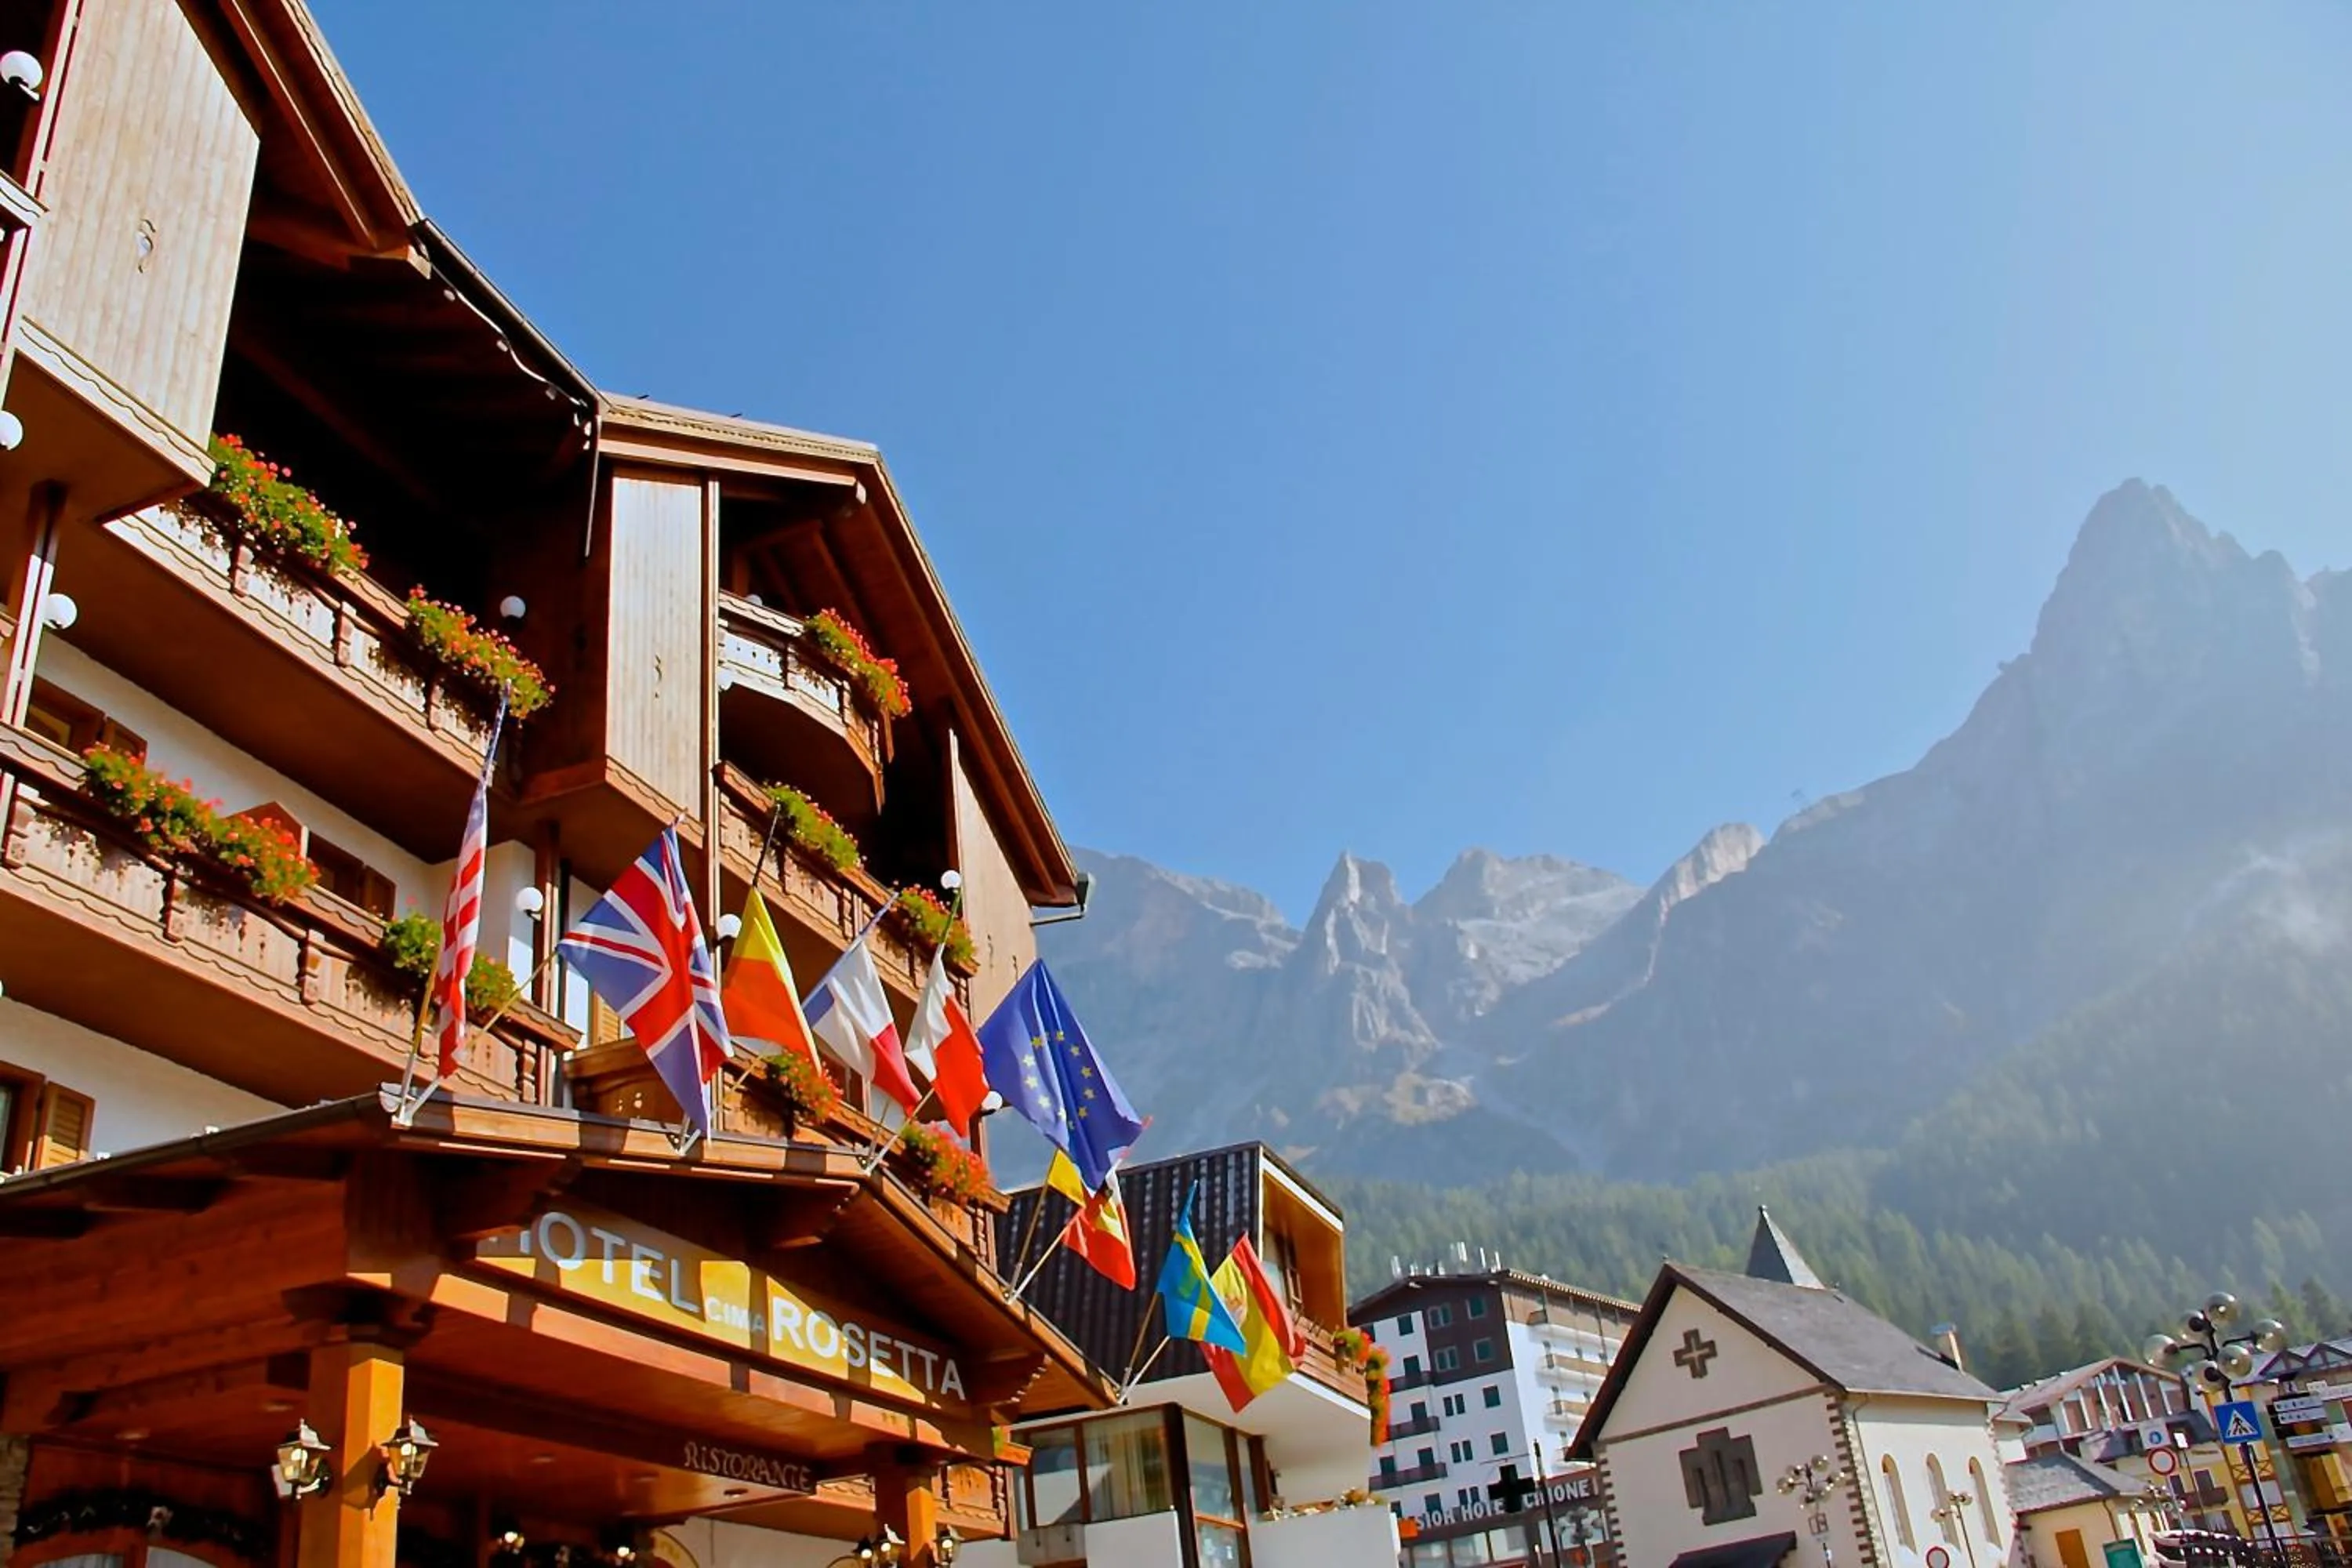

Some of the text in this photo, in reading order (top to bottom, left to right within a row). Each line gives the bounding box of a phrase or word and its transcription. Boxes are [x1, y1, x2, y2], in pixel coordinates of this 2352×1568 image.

[488, 1211, 966, 1401] OTEL CIMA ROSETTA
[1461, 1498, 1506, 1523] HOTE
